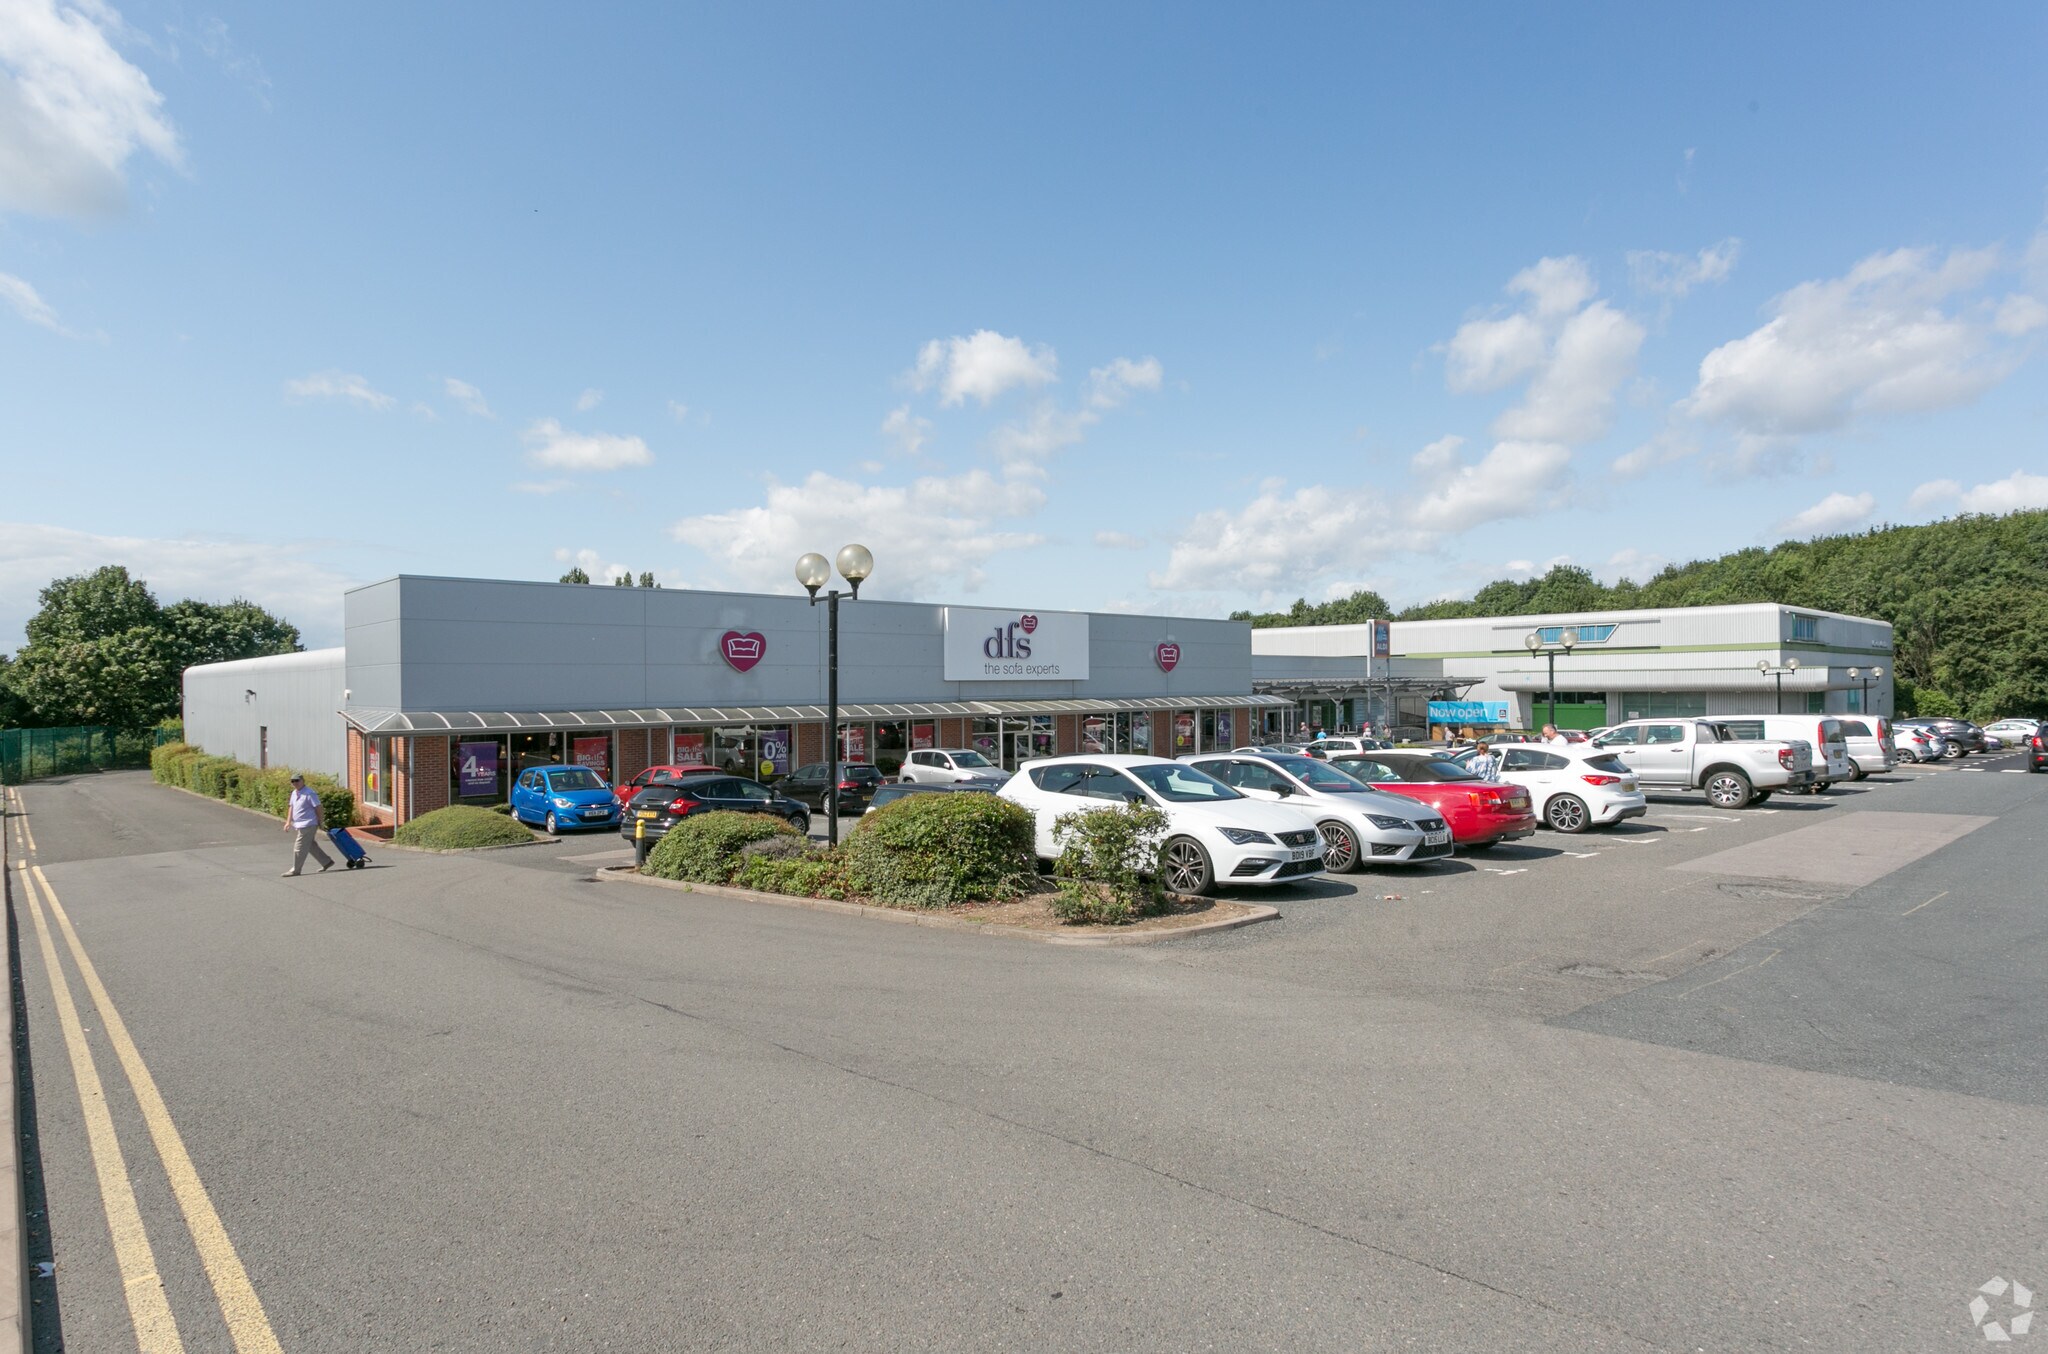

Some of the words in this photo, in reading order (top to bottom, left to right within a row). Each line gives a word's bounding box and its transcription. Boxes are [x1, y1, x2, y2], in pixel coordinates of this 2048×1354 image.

[983, 620, 1032, 660] dfs
[984, 663, 1000, 675] the
[1003, 663, 1023, 675] sofa
[1025, 664, 1060, 677] experts
[1429, 707, 1456, 718] Now
[1457, 708, 1488, 720] open
[677, 752, 702, 761] SALE
[462, 755, 478, 777] 4
